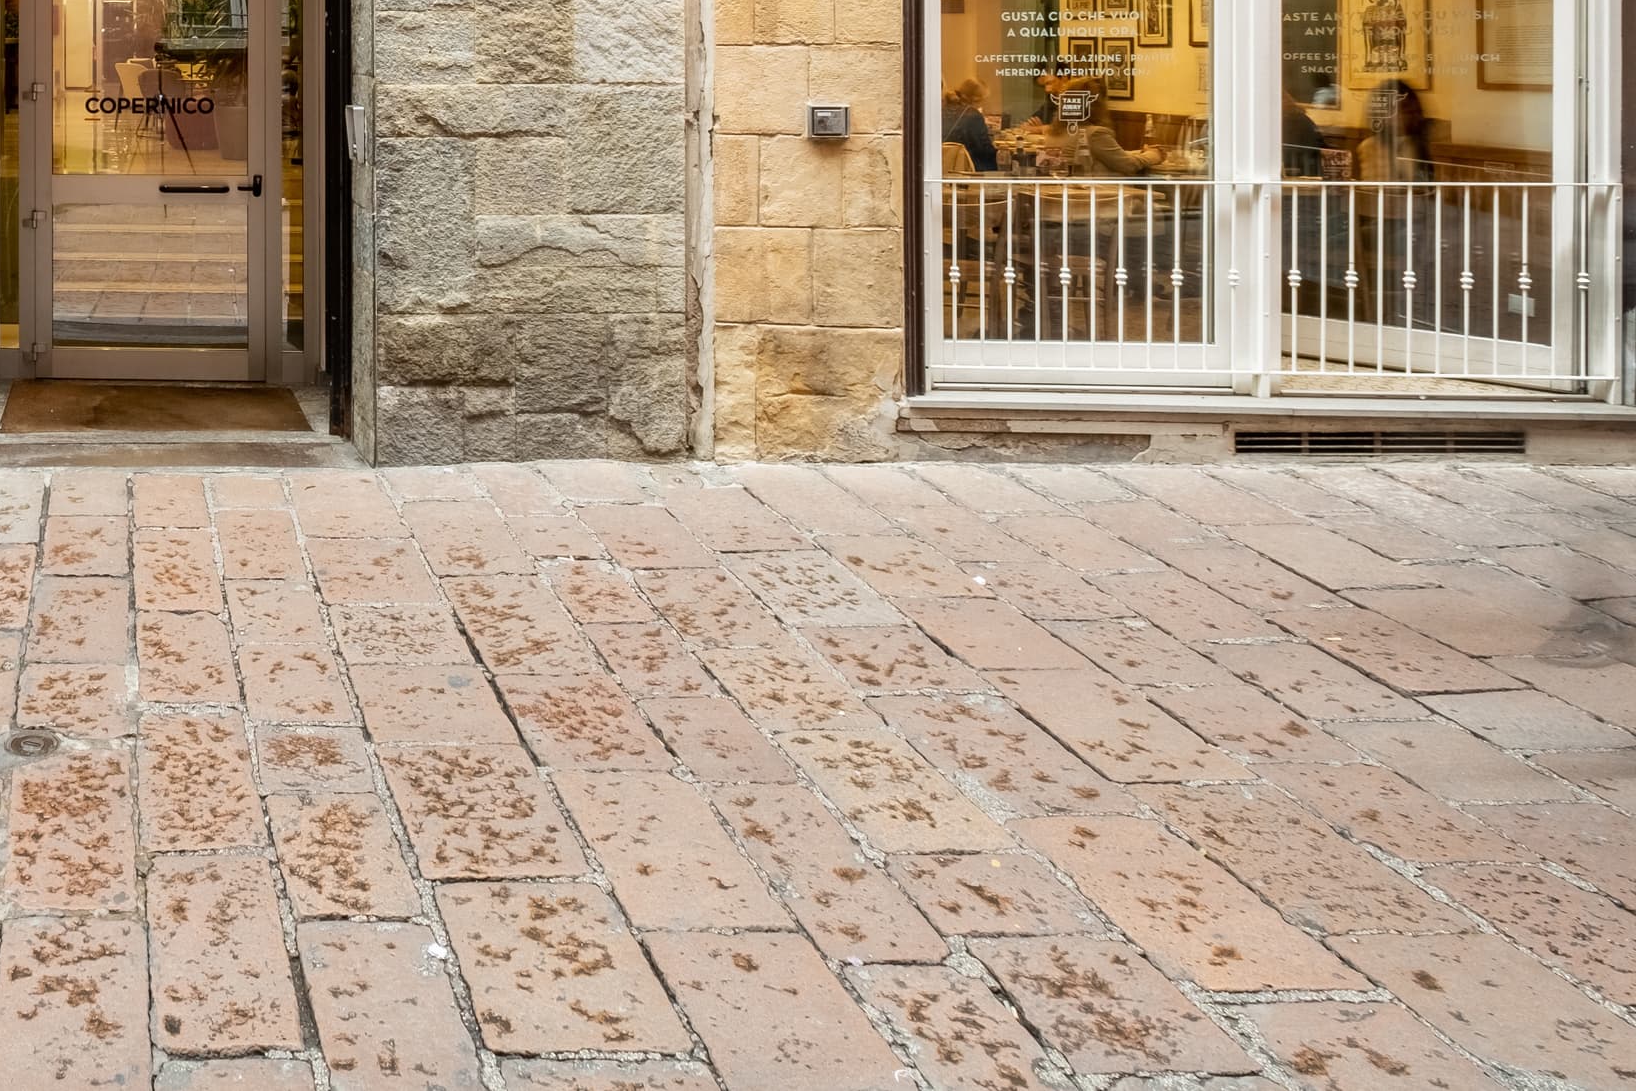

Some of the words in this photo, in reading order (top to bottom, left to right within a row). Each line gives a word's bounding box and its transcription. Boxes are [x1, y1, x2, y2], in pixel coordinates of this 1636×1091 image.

[1000, 11, 1045, 22] GUSTA
[1077, 11, 1106, 22] CHE
[1282, 11, 1319, 22] ASTE
[1007, 27, 1016, 38] A
[1019, 27, 1105, 38] QUALUNQUE
[1304, 26, 1373, 36] ANYME
[974, 54, 1048, 63] CAFFETTERIA
[1056, 53, 1122, 63] COLAZIONE
[1282, 52, 1321, 61] OFFEE
[995, 68, 1048, 77] MERENDA
[1056, 67, 1114, 77] APERITIVO
[84, 97, 215, 115] COPERNICO
